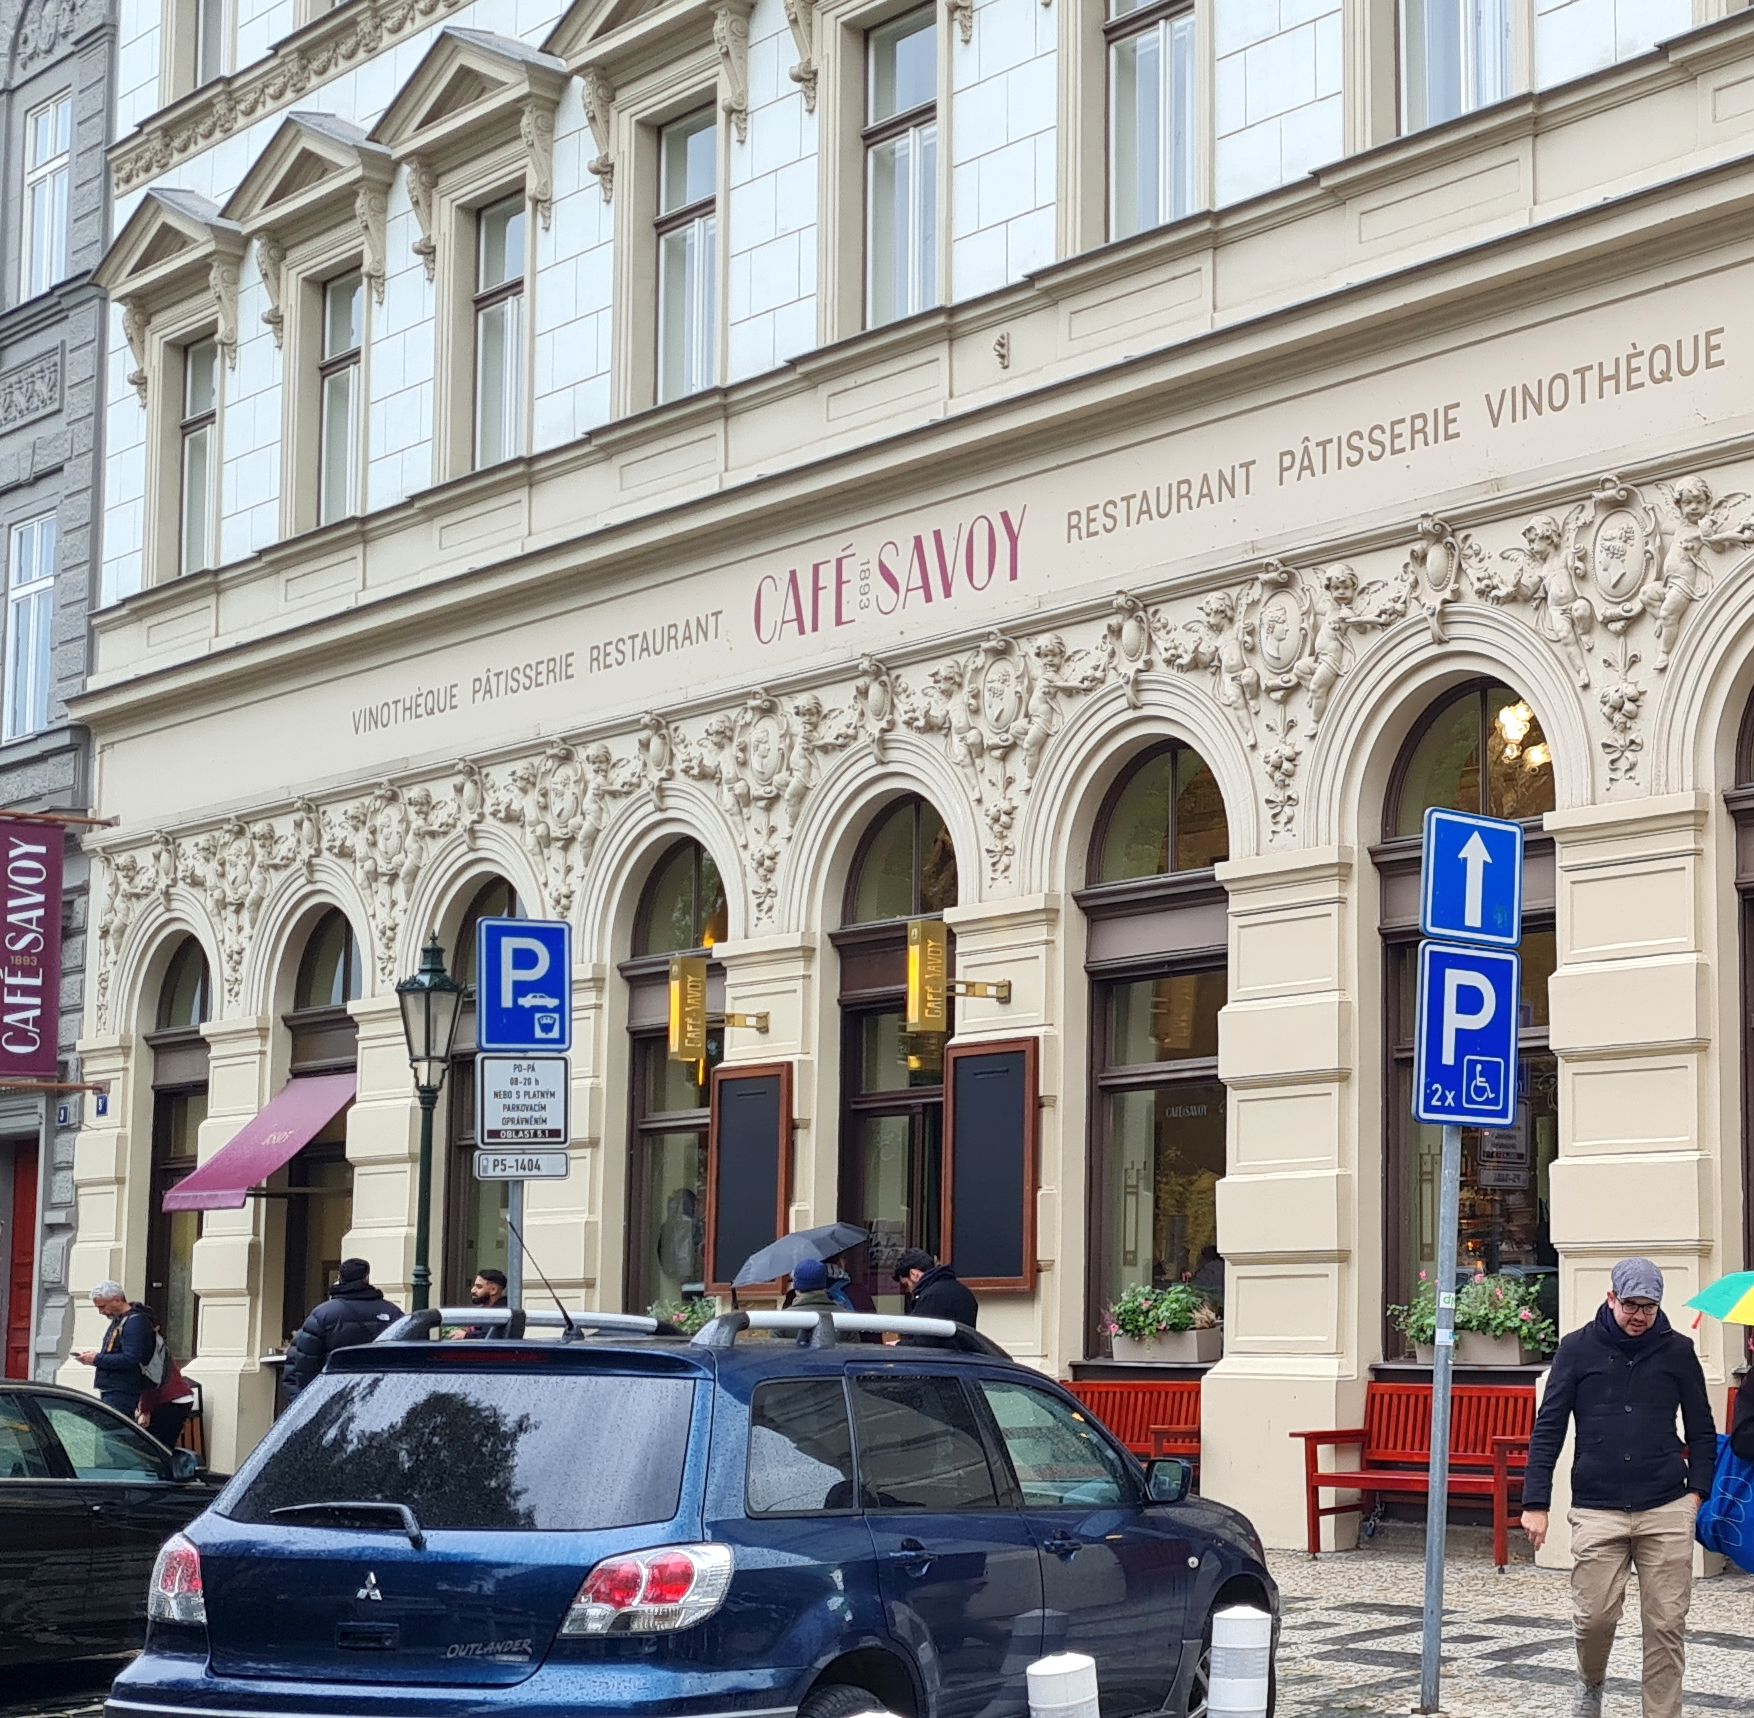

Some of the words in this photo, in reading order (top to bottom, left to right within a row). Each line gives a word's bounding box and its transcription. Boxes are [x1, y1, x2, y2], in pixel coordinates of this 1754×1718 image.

[1067, 459, 1256, 543] RESTAURANT
[1278, 402, 1461, 486] PÂTISSERIE
[1485, 326, 1726, 428] VINOTHÈQUE
[754, 543, 856, 644] CAFÉ
[859, 558, 871, 610] 1893
[876, 503, 1027, 615] SAVOY
[352, 683, 458, 735] VINOTHÈQUE
[472, 652, 575, 705] PÂTISSERIE
[589, 610, 723, 674] RESTAURANT
[5, 837, 47, 953] SAVOY
[10, 955, 38, 966] 1893
[501, 937, 550, 1008] P
[0, 965, 43, 1054] CAFÉ
[1442, 968, 1496, 1066] P
[513, 1062, 536, 1073] PO-PÁ
[493, 1090, 512, 1099] NEBO
[523, 1088, 556, 1099] PLATNÝM
[1431, 1083, 1455, 1107] 2x
[502, 1101, 547, 1112] PARKOVACÍM
[500, 1130, 535, 1138] OBLAST
[493, 1159, 541, 1172] P5-1404
[447, 1639, 532, 1658] OUTLANDER
